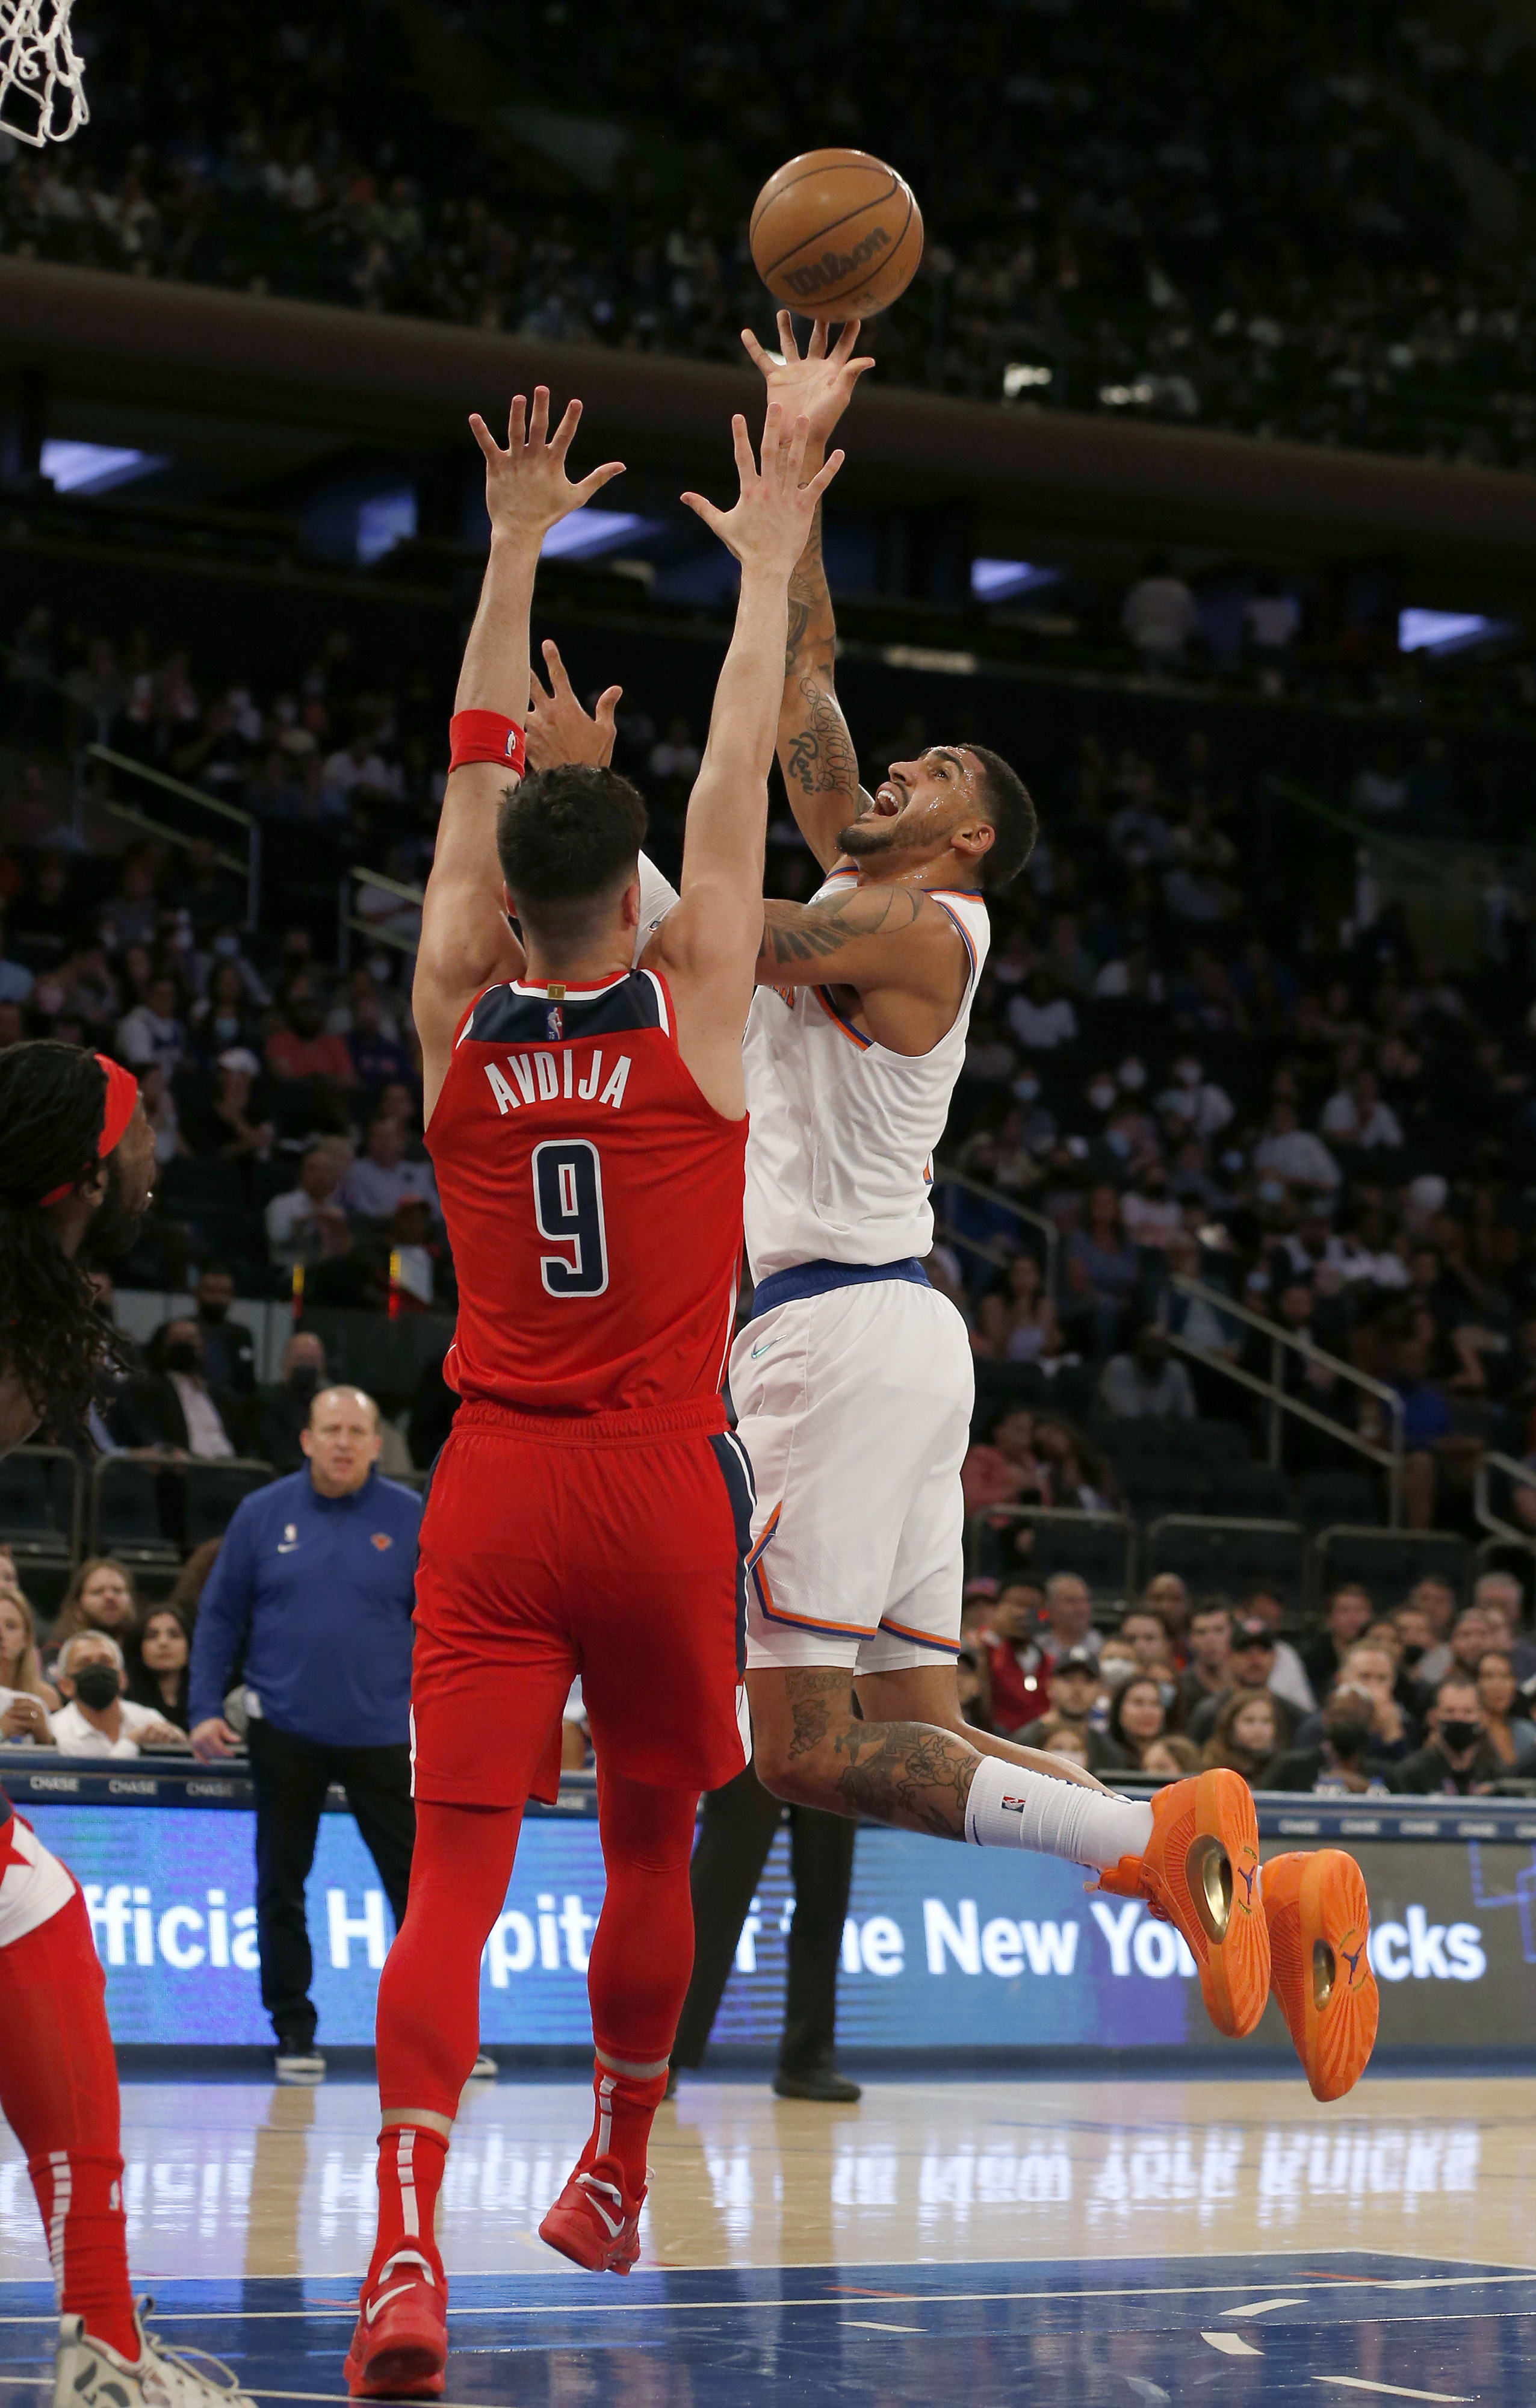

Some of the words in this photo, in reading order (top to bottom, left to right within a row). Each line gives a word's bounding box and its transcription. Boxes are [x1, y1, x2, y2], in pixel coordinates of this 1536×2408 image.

[782, 226, 892, 296] Wilson
[483, 1049, 632, 1116] AVDIJA
[531, 1139, 609, 1298] 9
[922, 1897, 1079, 1978] New
